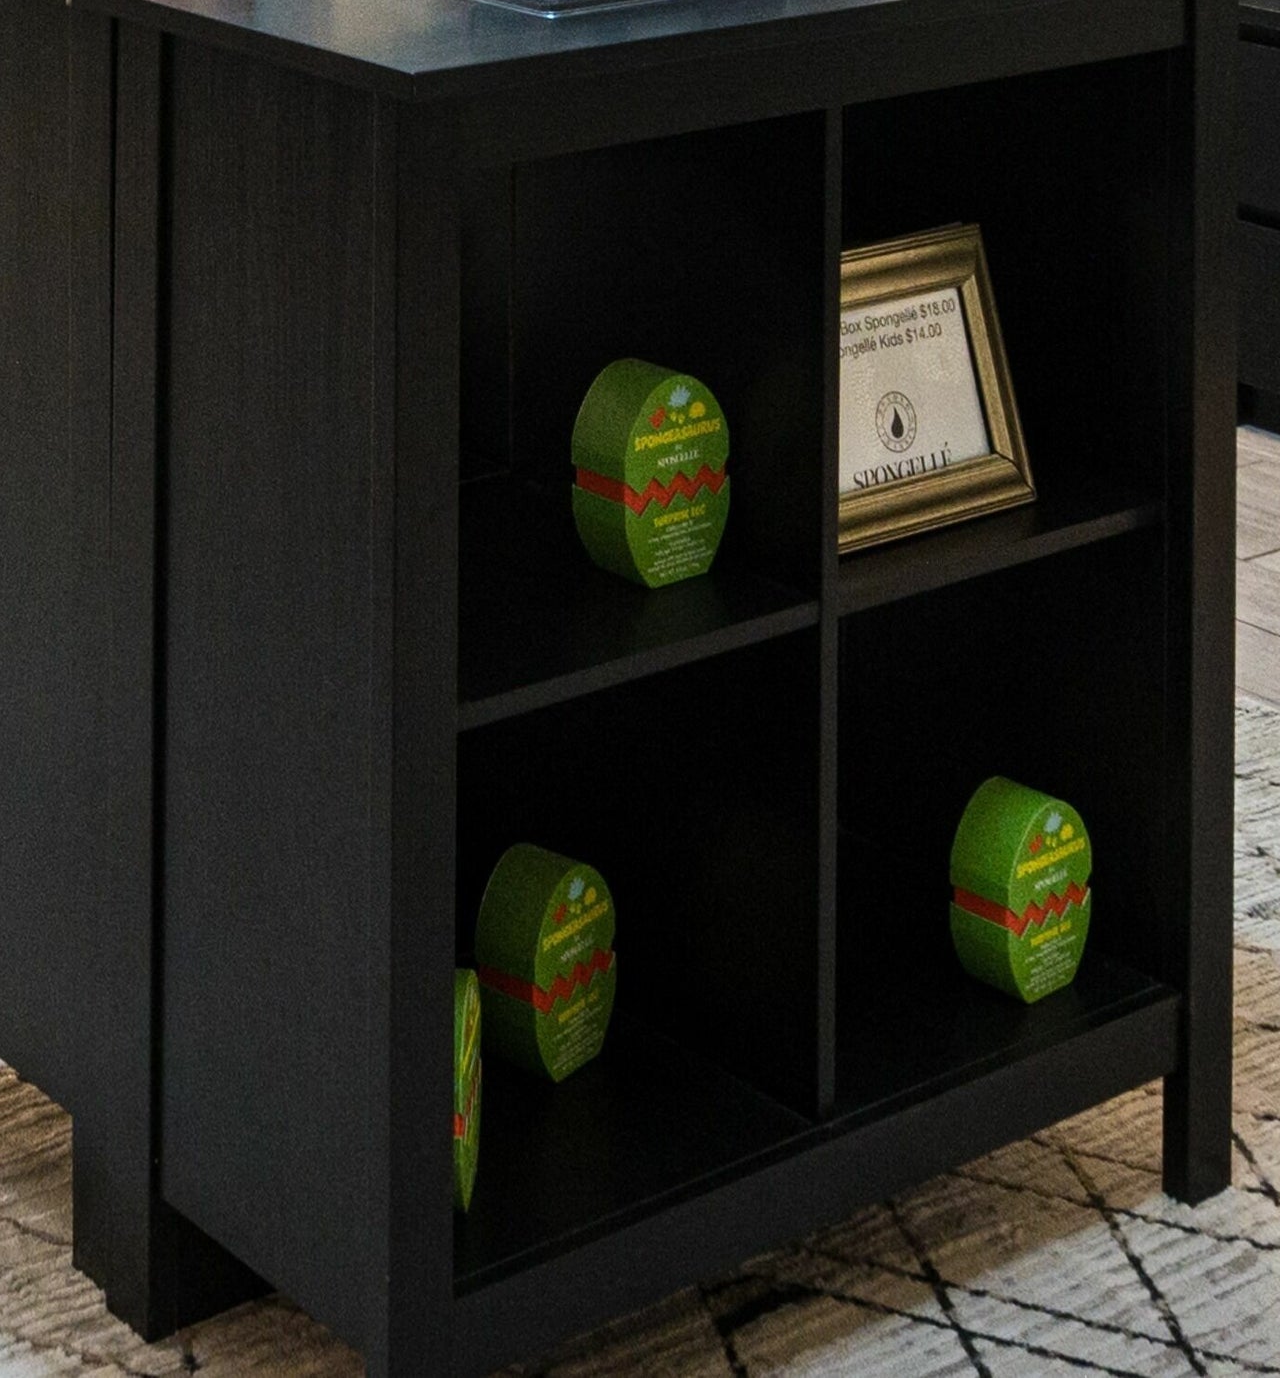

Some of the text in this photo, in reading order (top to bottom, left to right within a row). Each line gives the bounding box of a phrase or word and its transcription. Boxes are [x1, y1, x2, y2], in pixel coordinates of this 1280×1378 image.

[840, 298, 956, 336] Box Spongellé $18.00
[840, 322, 942, 359] ongellé Kids $14.00
[853, 441, 952, 489] SPONGELLÉ
